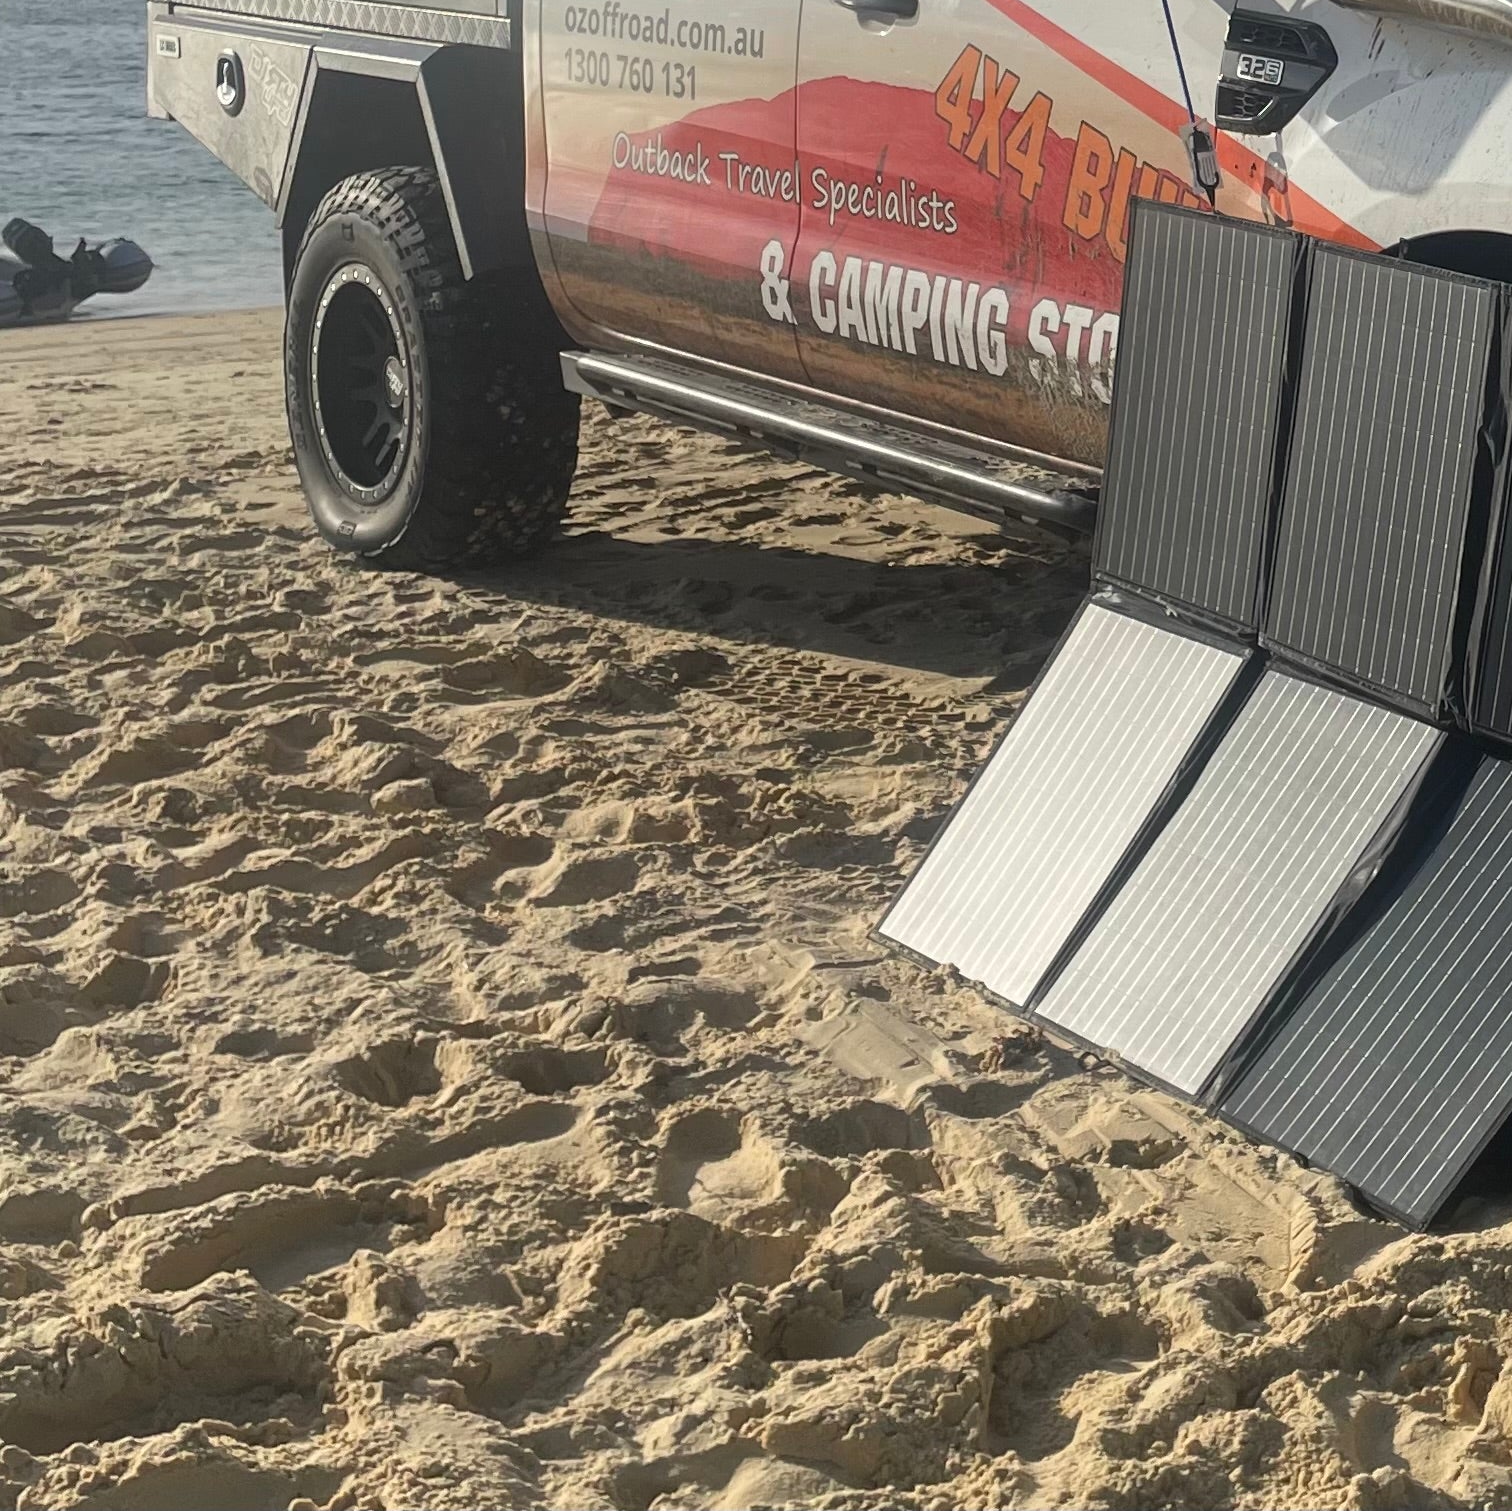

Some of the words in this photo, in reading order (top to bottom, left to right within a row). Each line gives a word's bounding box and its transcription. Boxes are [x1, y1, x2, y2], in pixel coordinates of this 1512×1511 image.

[565, 0, 764, 58] ozoffroad.com.au
[565, 47, 610, 87] 1300
[616, 54, 654, 93] 760
[662, 61, 696, 100] 131
[935, 42, 1053, 203] 4X4
[612, 133, 711, 185] Outback
[718, 152, 800, 204] Travel
[811, 168, 958, 234] Specialists
[760, 239, 798, 325] &
[808, 251, 1010, 377] CAMPING
[1027, 298, 1120, 405] STO
